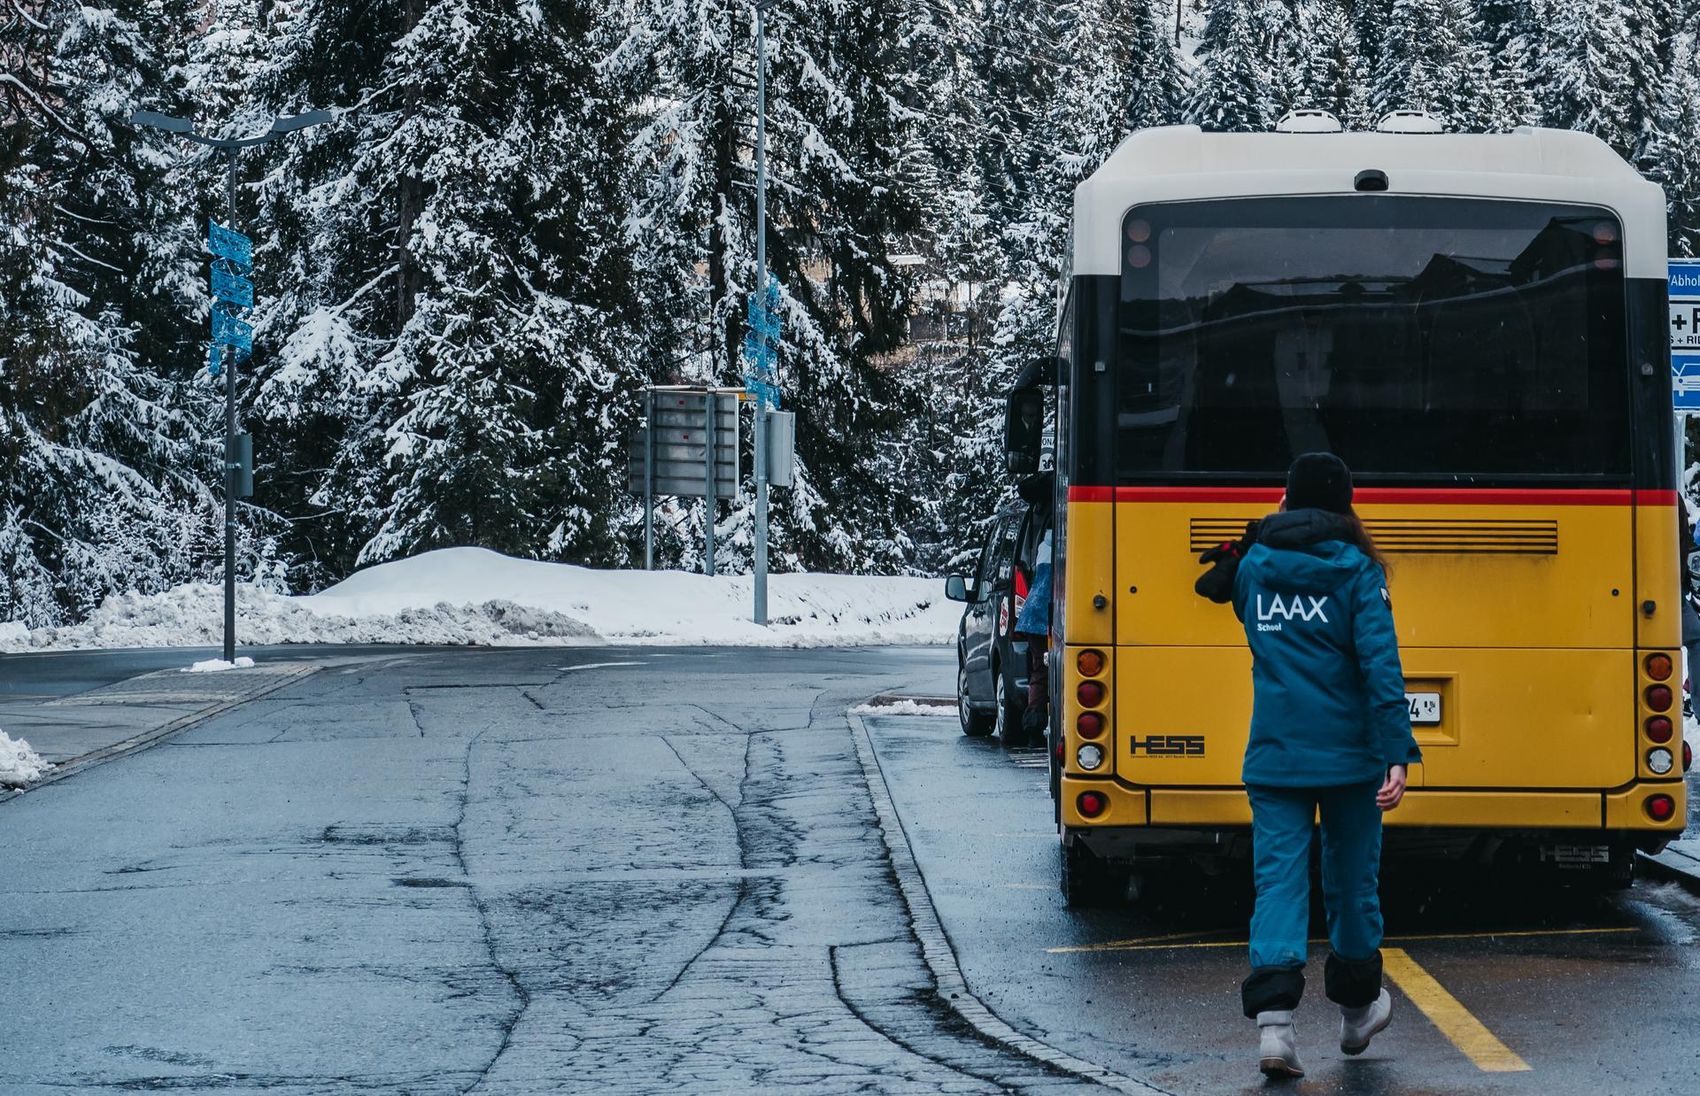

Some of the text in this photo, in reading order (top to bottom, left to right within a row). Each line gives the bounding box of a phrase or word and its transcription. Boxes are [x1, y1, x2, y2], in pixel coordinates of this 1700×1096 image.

[1257, 593, 1329, 623] LAAX
[1257, 623, 1282, 632] School
[1130, 736, 1205, 754] HESS
[1539, 845, 1609, 863] HESS
